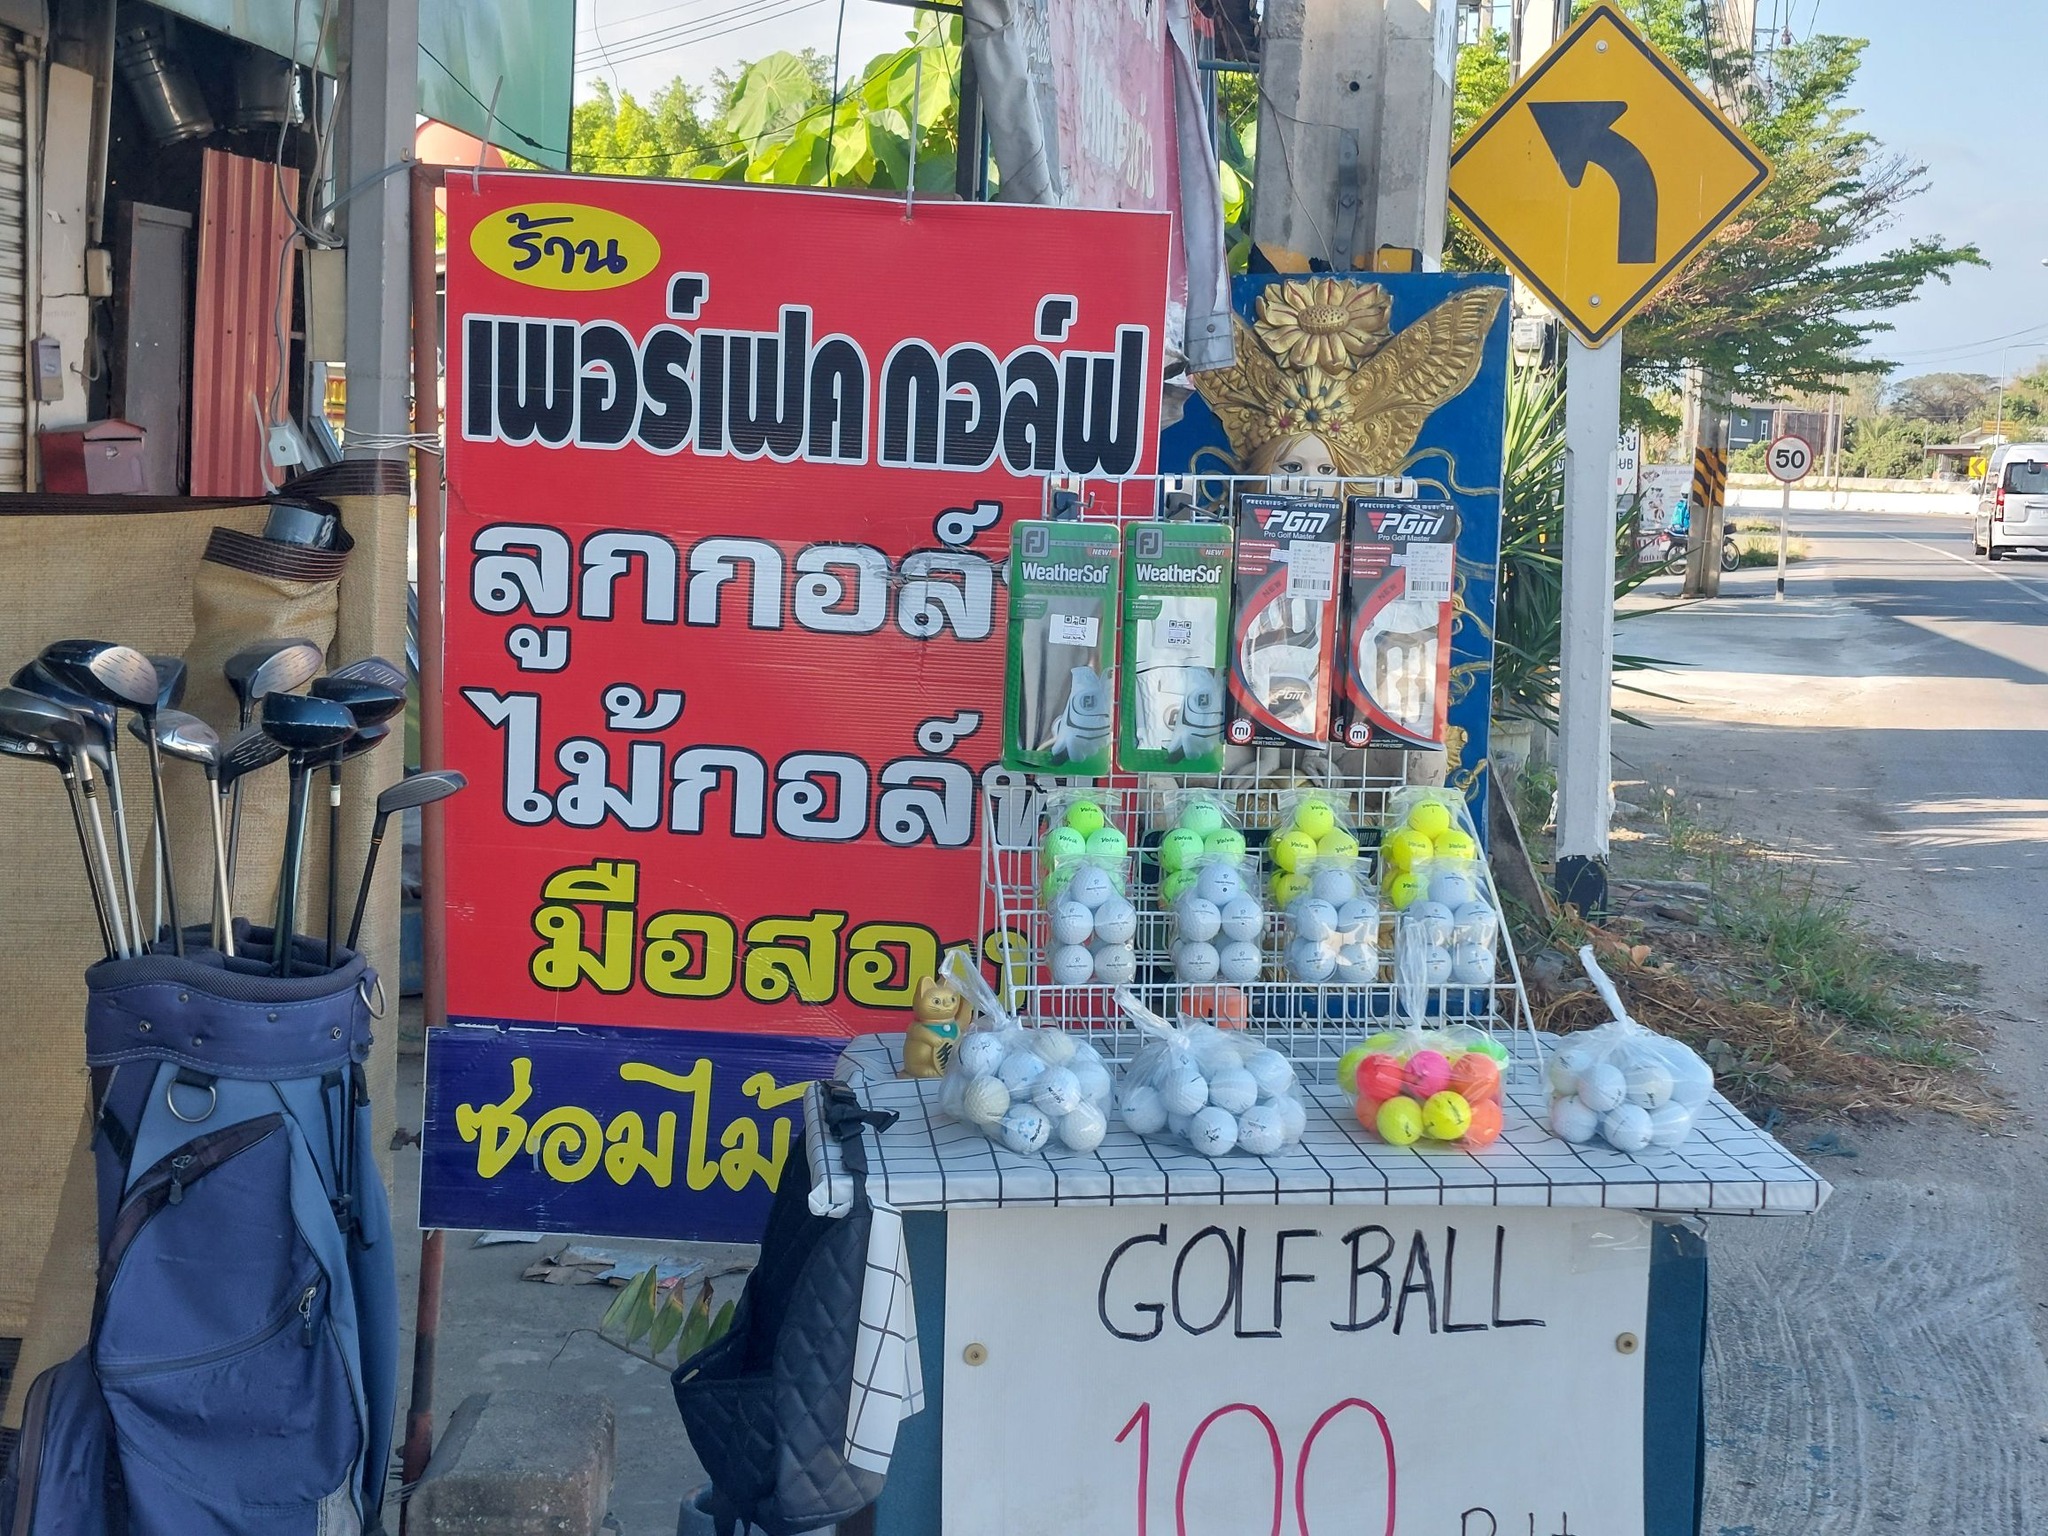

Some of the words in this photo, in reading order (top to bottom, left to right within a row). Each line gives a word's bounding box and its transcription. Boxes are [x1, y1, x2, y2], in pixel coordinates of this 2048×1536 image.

[506, 212, 629, 275] ร้าน
[877, 294, 1150, 478] กอล์ฟ
[1775, 449, 1806, 470] 50
[1263, 509, 1331, 534] PGM
[1263, 530, 1276, 538] Pro
[1277, 531, 1292, 539] Golf
[1292, 532, 1317, 540] Master
[1377, 533, 1390, 541] Pro
[1091, 548, 1113, 557] NEW!
[1205, 548, 1225, 557] NEW!
[1021, 561, 1110, 584] WeatherSof
[1136, 563, 1223, 584] WeatherSof
[469, 500, 1010, 674] ลูกกอล์
[529, 858, 1032, 1013] มือสอง
[455, 1056, 817, 1194] ซ่อมไม้
[1097, 1222, 1323, 1342] GOLF
[1329, 1224, 1546, 1337] BALL
[1114, 1396, 1398, 1536] 100
